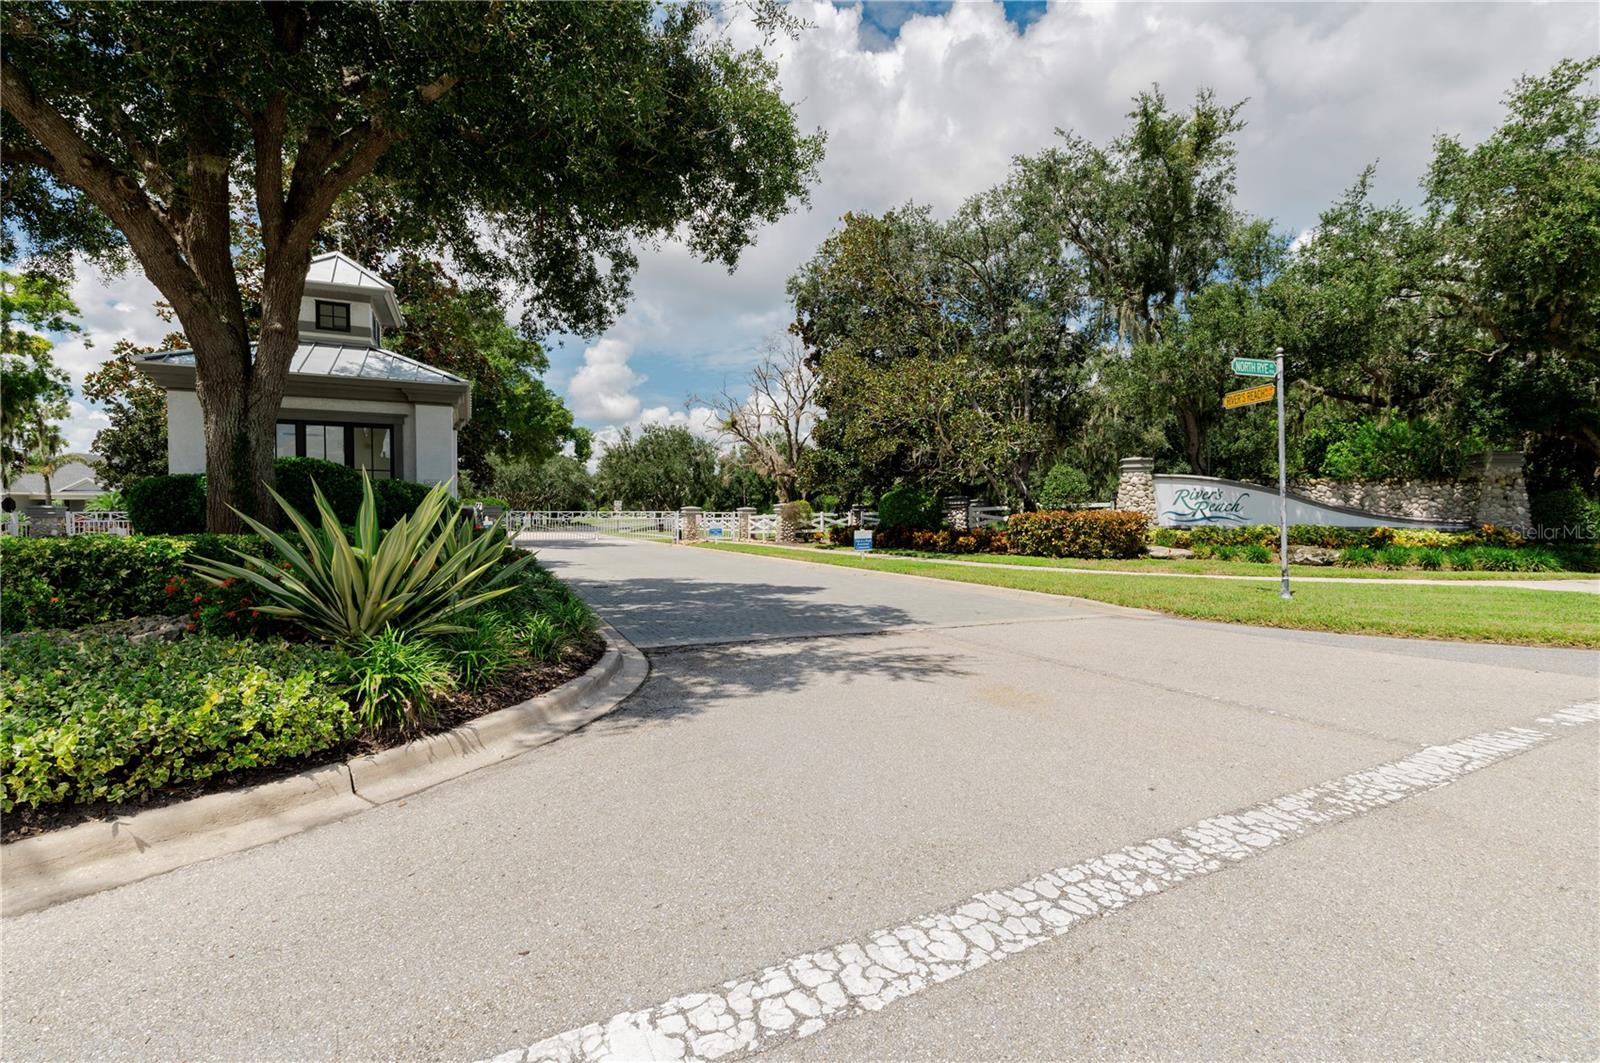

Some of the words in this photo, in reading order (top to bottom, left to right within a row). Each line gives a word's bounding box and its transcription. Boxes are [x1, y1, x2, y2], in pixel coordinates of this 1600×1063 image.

[1235, 361, 1256, 373] NORTH
[1256, 363, 1269, 374] RYE
[1226, 393, 1246, 406] RIVER'S
[1247, 388, 1265, 402] REACH
[1173, 488, 1223, 511] River's
[1192, 493, 1250, 522] Reach
